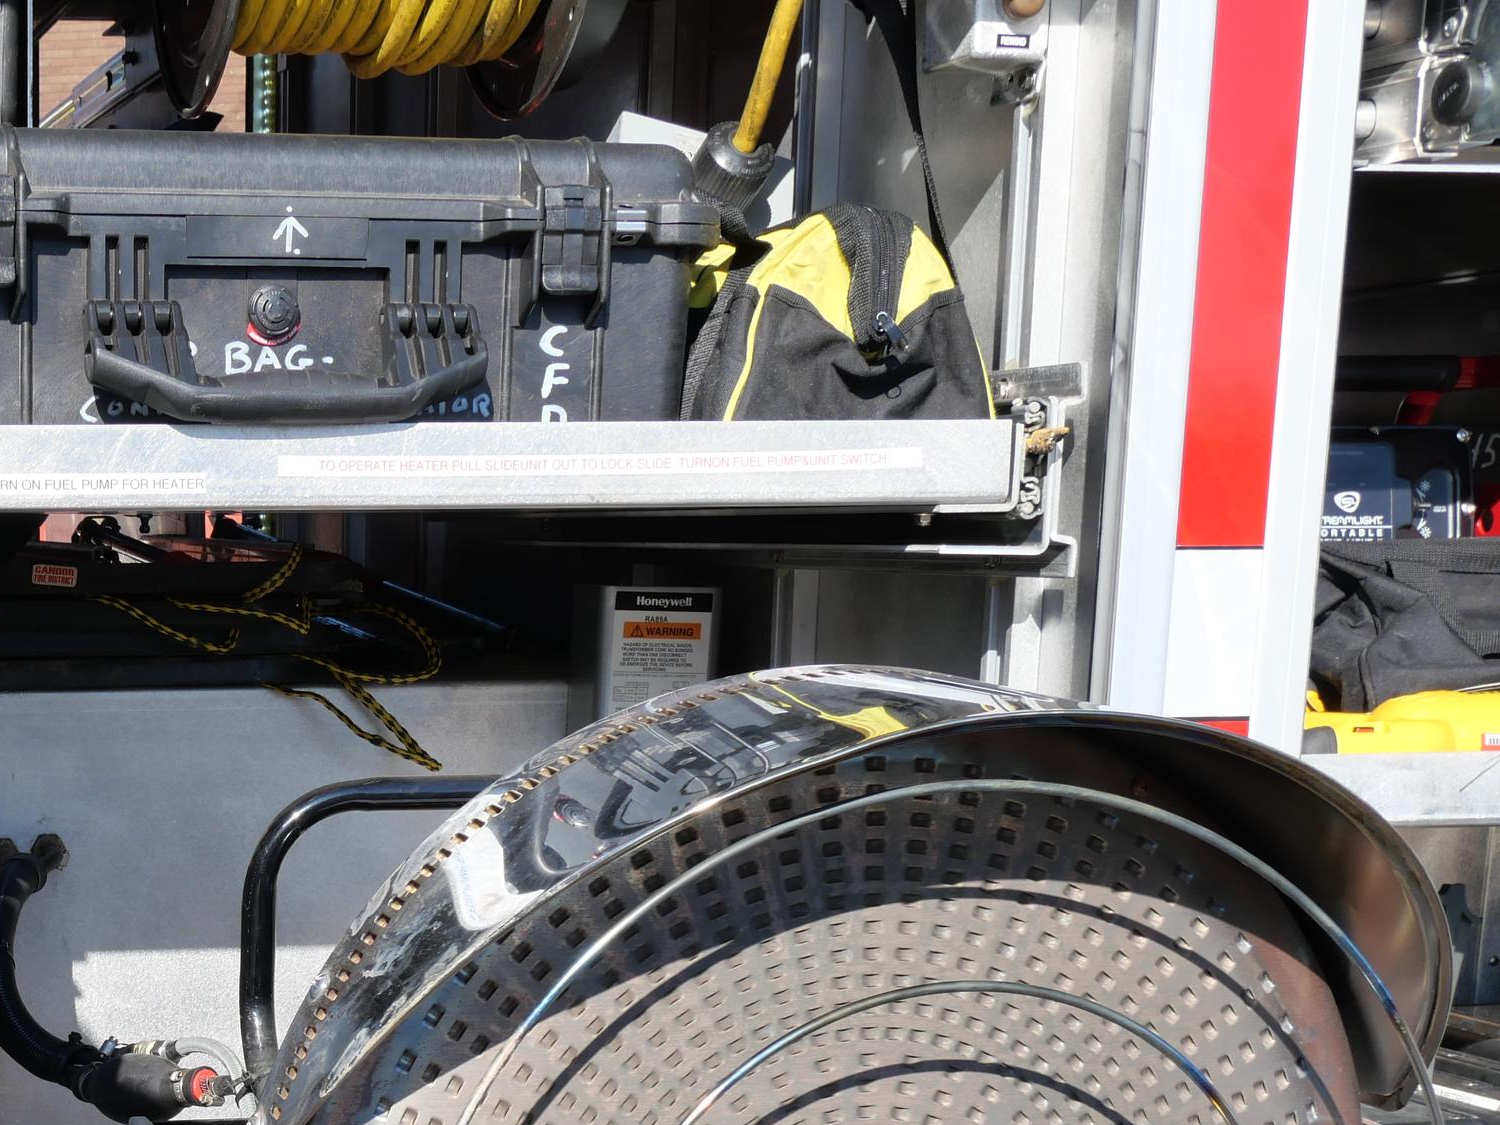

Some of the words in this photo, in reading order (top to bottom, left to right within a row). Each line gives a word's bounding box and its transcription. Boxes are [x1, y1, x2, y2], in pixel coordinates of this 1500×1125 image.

[319, 460, 336, 472] TO
[338, 460, 396, 472] OPERATE
[400, 460, 449, 472] HEATER
[452, 459, 480, 471] PULL
[552, 459, 578, 471] OUT
[582, 458, 598, 470] TO
[601, 458, 634, 470] LOCK
[637, 457, 672, 469] SLIDE
[733, 456, 764, 468] FUEL
[840, 453, 887, 465] SWITCH
[21, 479, 41, 491] ON
[45, 479, 77, 490] FUEL
[81, 478, 119, 490] PUMP
[122, 478, 149, 490] FOR
[153, 477, 204, 489] HEATER
[48, 575, 74, 585] DISTRICT
[636, 596, 693, 608] Honeywell
[645, 627, 694, 637] WARNING
